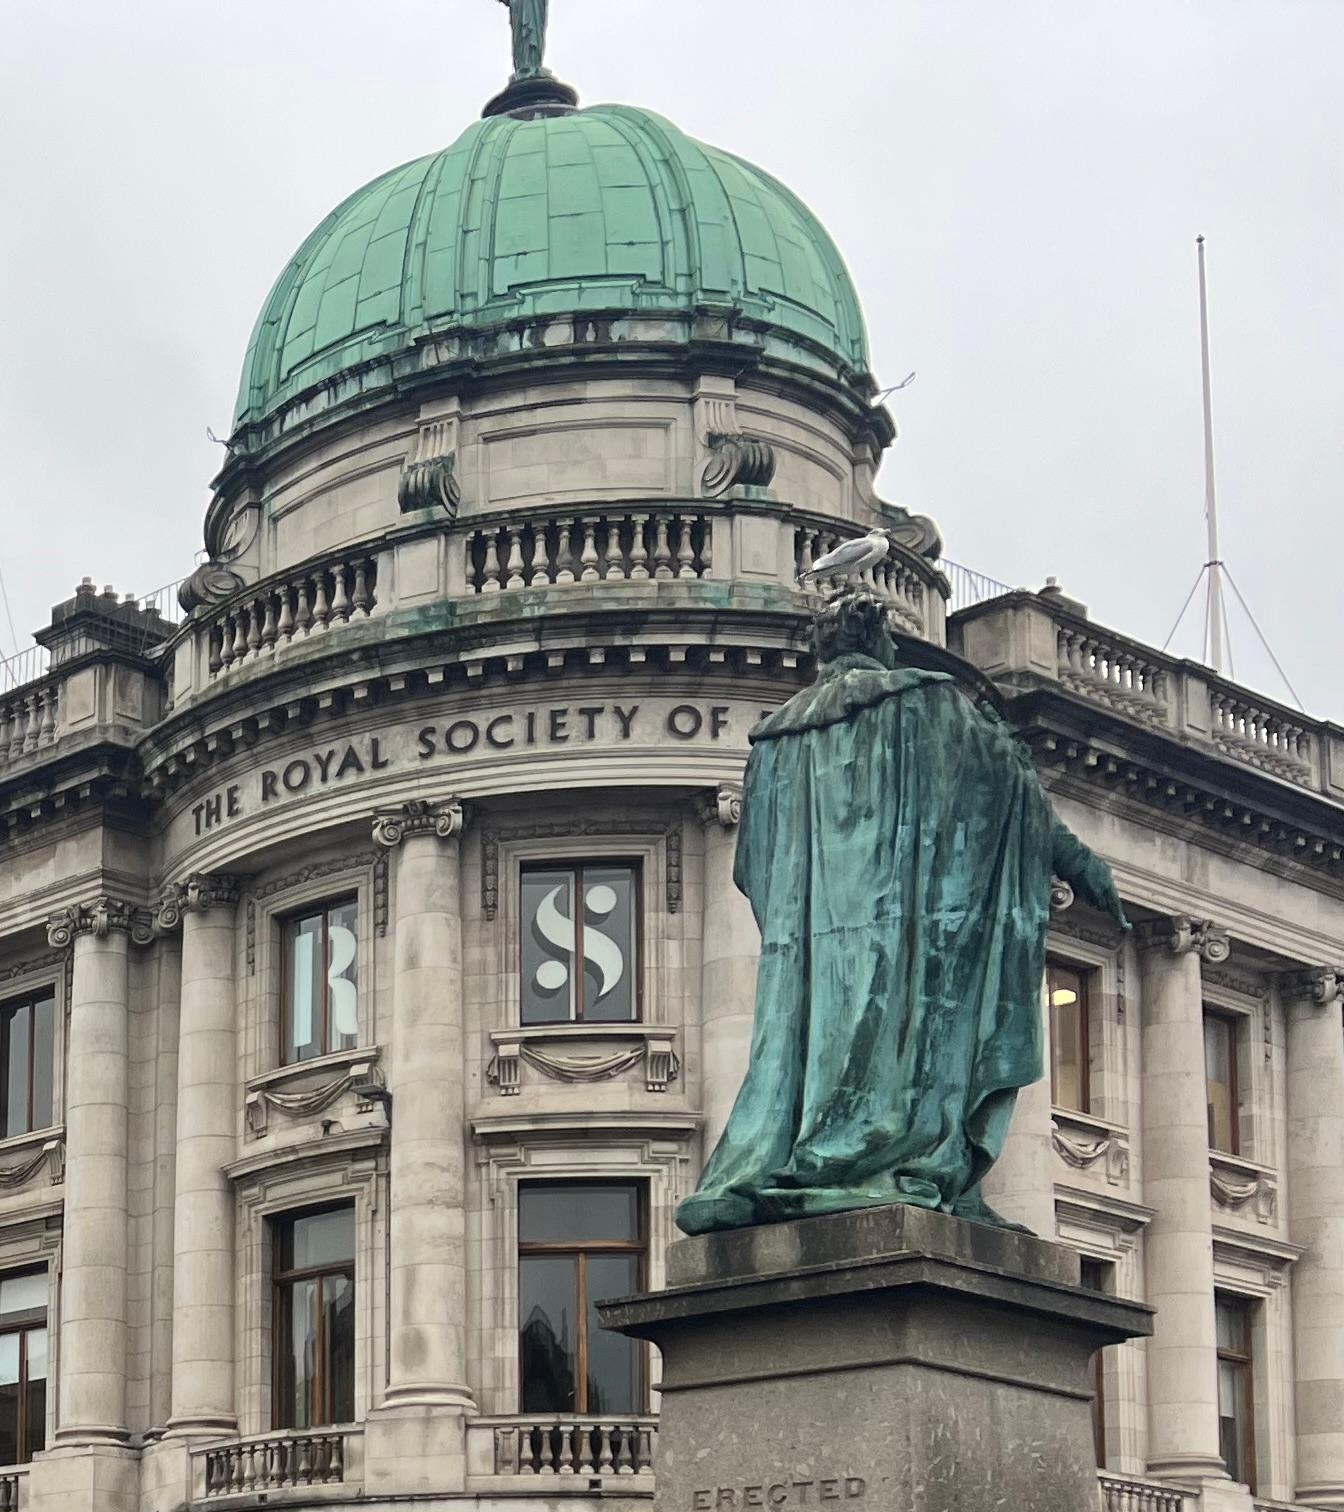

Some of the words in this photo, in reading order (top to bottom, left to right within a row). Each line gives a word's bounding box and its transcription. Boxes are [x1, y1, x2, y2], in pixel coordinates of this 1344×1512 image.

[191, 784, 240, 836] THE
[261, 737, 389, 802] ROYAL
[417, 704, 640, 759] SOCIETY
[666, 704, 731, 740] OF
[692, 1477, 866, 1511] ERECTED
